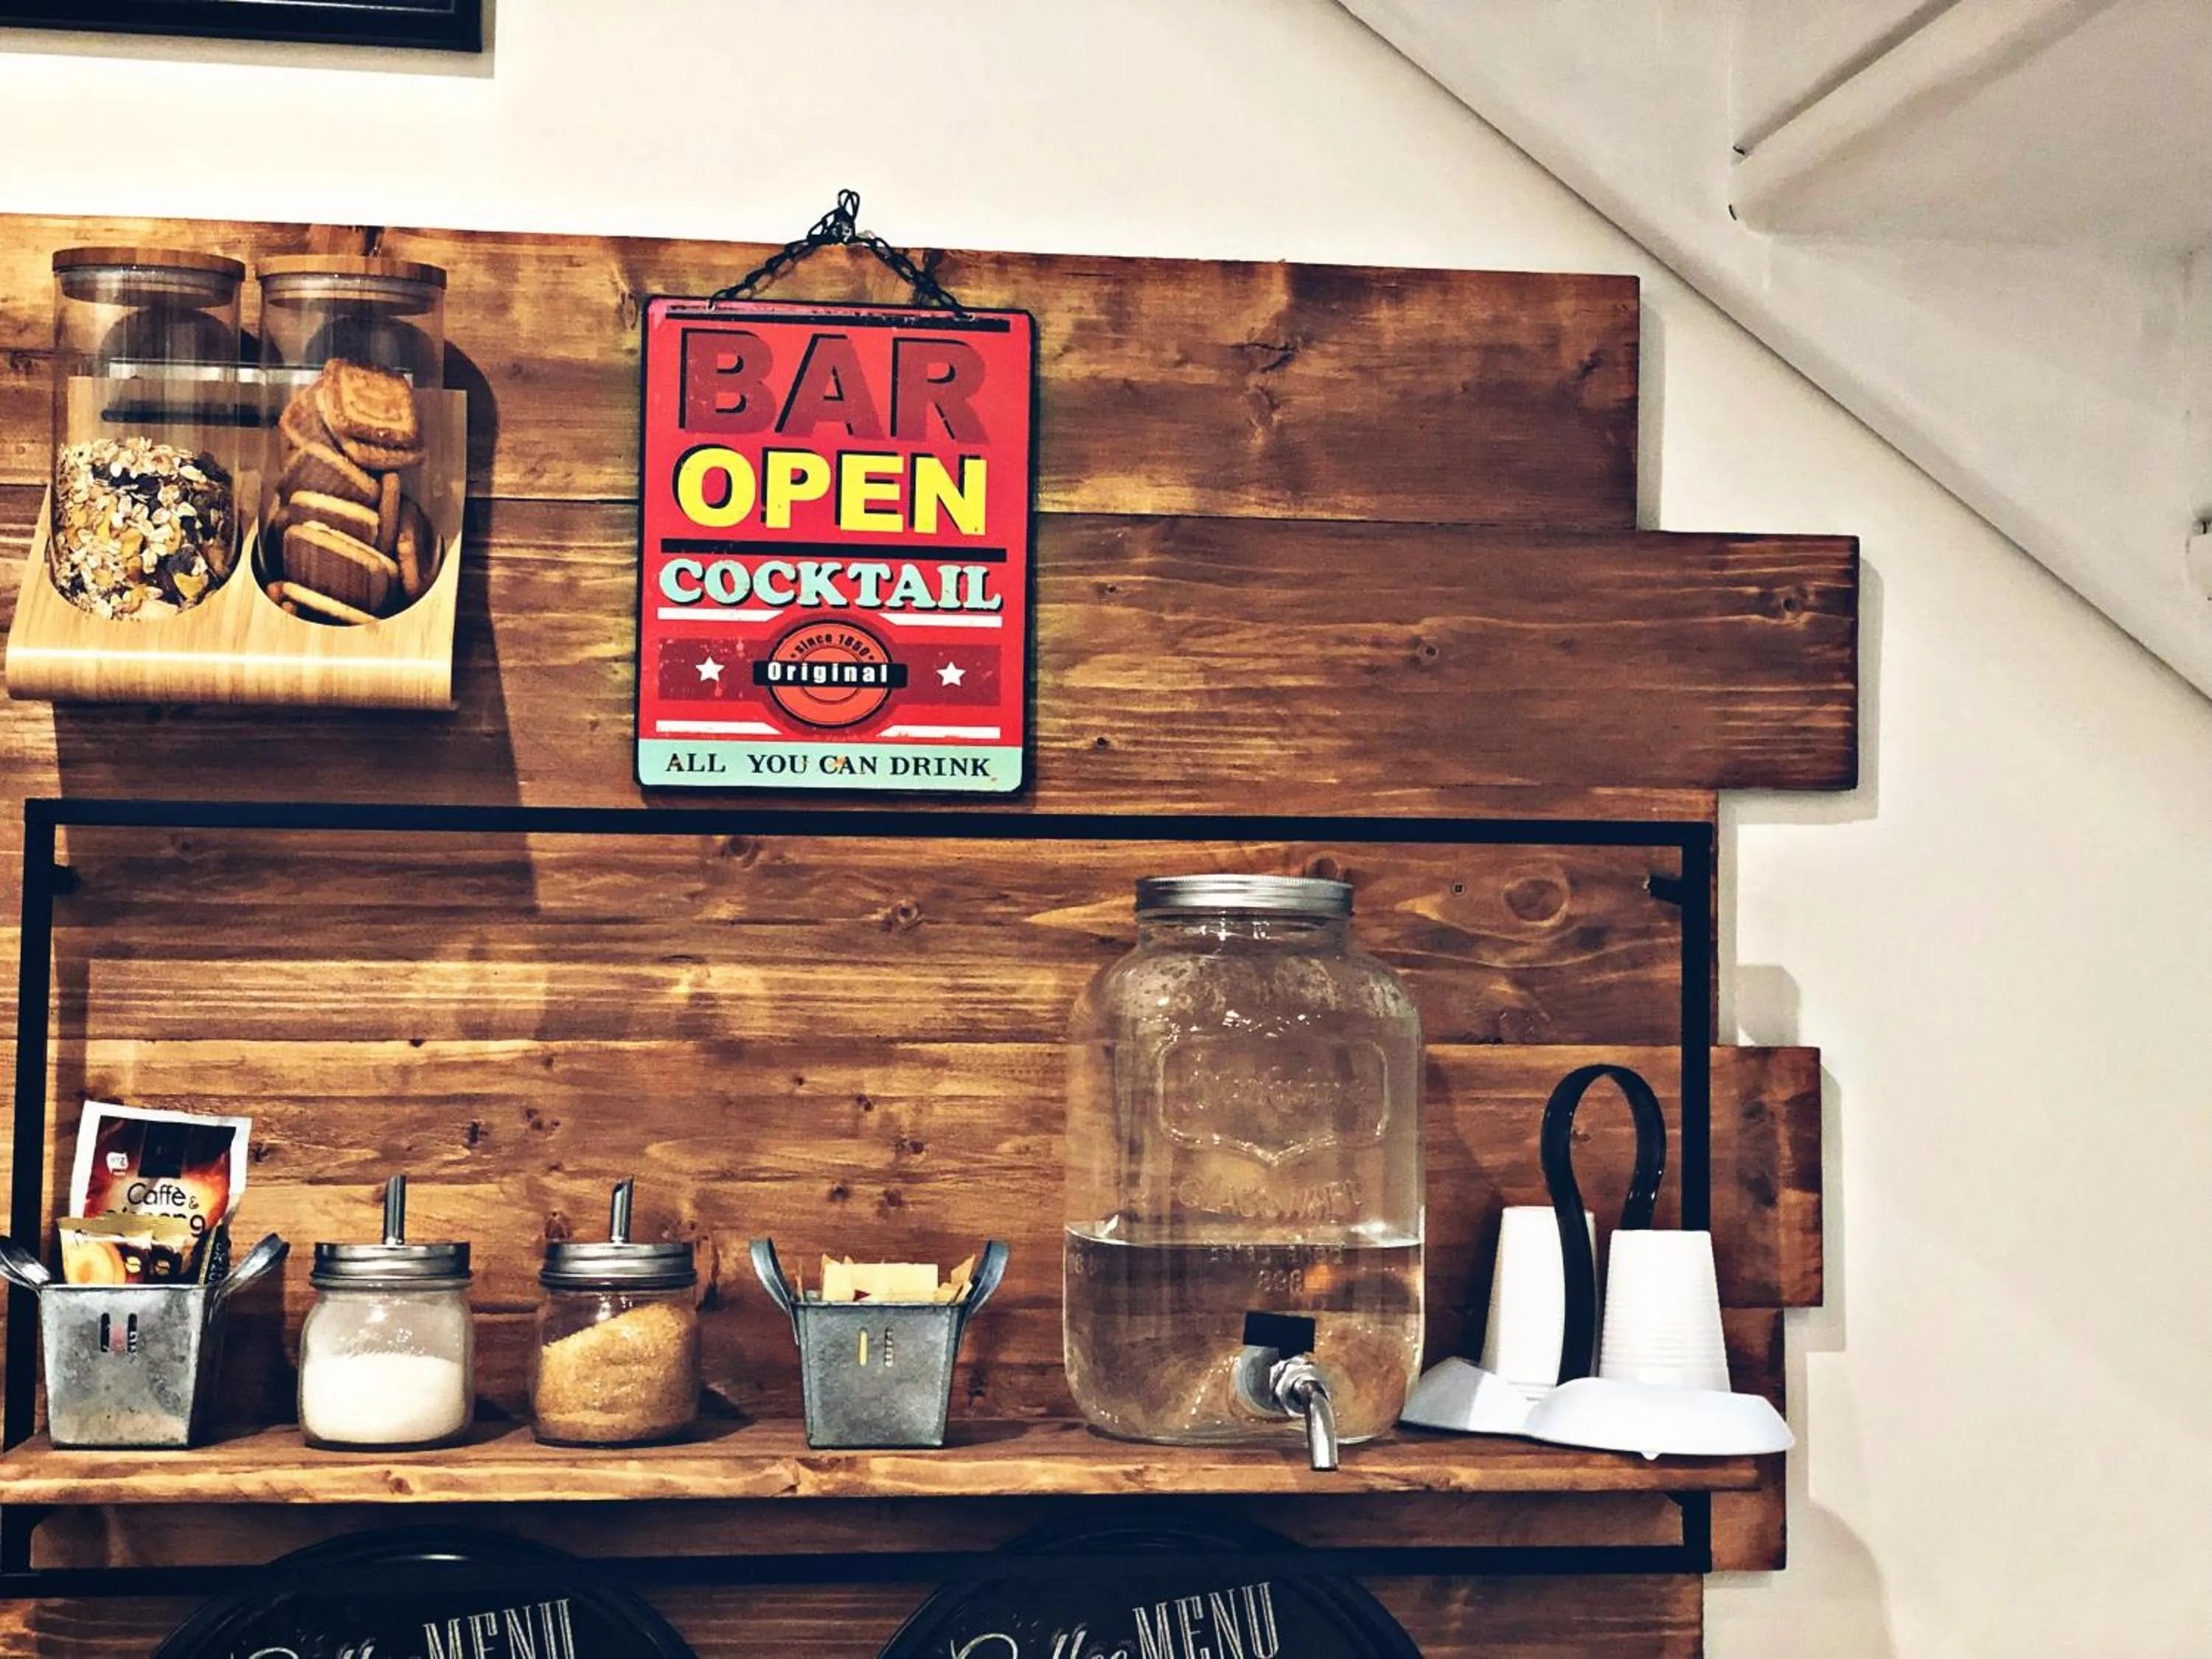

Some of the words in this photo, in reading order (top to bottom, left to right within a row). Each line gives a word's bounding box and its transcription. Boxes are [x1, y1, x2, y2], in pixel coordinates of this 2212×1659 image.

[678, 327, 990, 442] BAR
[672, 443, 987, 536] OPEN
[659, 558, 1003, 611] COCKTAIL
[795, 633, 832, 654] since
[768, 661, 888, 684] Original
[665, 753, 726, 773] ALL
[748, 754, 808, 774] YOU
[819, 755, 878, 775] CAN
[890, 757, 990, 776] DRINK
[127, 1182, 187, 1207] Caffè
[189, 1195, 200, 1210] &
[1132, 1582, 1281, 1659] MENU
